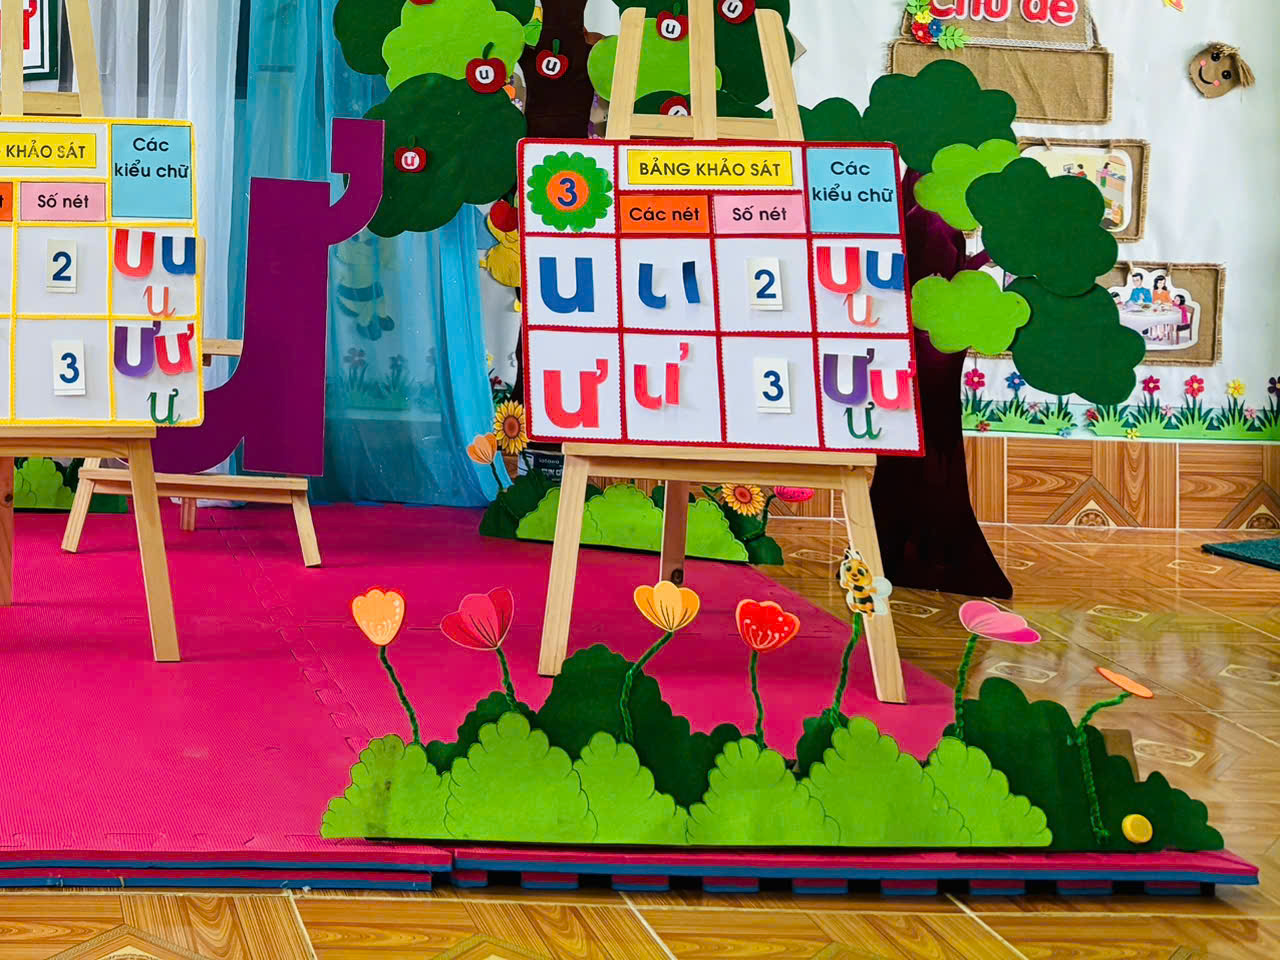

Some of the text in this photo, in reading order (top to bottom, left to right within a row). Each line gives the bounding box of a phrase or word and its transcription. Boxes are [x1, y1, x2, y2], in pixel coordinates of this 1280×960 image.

[726, 1, 739, 15] u
[665, 23, 676, 35] u
[478, 69, 490, 80] u
[545, 59, 558, 73] u
[6, 140, 53, 158] KHẢO
[57, 141, 85, 158] SÁT
[132, 137, 169, 152] Các
[114, 160, 189, 178] kiểu chữ
[640, 157, 780, 177] BẢNG KHẢO SÁT
[830, 161, 870, 176] Các
[37, 192, 89, 208] Số nét
[557, 177, 577, 206] 3
[812, 184, 894, 203] kiểu chữ
[629, 207, 700, 221] Các nét
[732, 206, 787, 221] Số nét
[52, 251, 72, 281] 2
[539, 257, 595, 313] u
[754, 269, 777, 299] 2
[60, 352, 80, 384] 3
[543, 358, 609, 429] ư
[762, 370, 784, 402] 3
